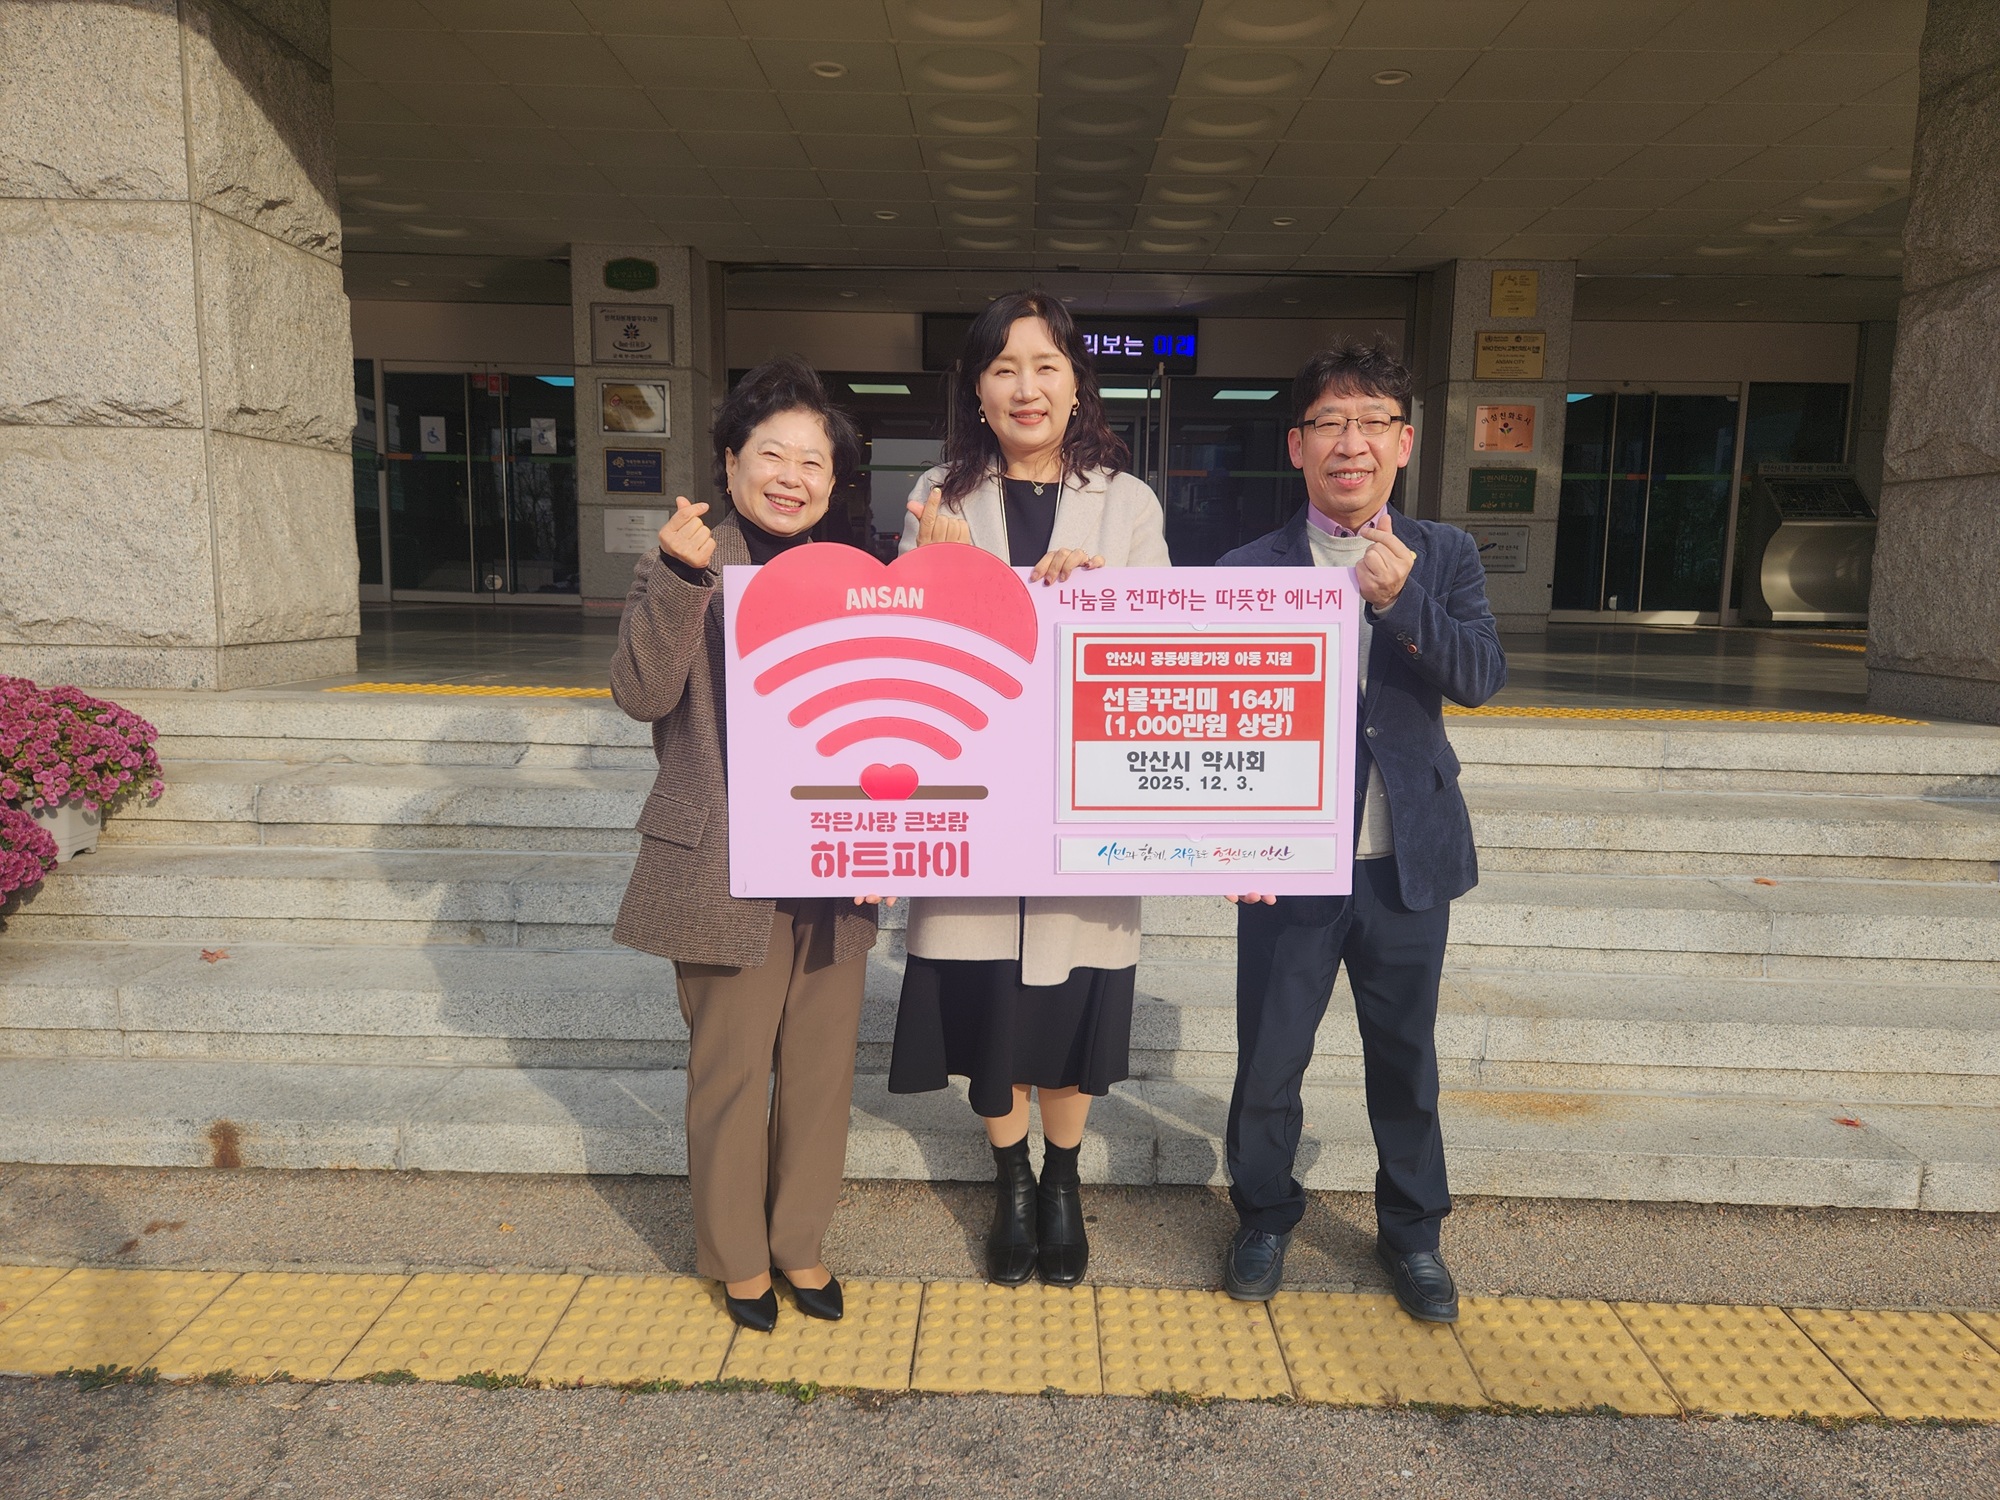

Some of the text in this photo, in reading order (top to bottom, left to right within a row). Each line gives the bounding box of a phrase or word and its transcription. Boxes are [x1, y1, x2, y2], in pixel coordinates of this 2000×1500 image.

[1154, 335, 1195, 357] 미래
[846, 585, 924, 611] ANSAN
[1059, 588, 1343, 612] 나눔을 전파하는 따뜻한 에너지
[1105, 651, 1293, 667] 안산시 공동생활가정 아동 지원
[1102, 687, 1295, 712] 선물꾸러미 164개
[1104, 713, 1293, 738] (1,000만원 상당)
[1126, 750, 1265, 773] 안산시 약사회
[1138, 776, 1253, 792] 2025. 12. 3.
[810, 811, 970, 833] 작은사랑 큰보람
[810, 840, 970, 879] 하트파이
[1097, 841, 1138, 866] 시민과
[1169, 847, 1209, 867] 자유로운
[1213, 846, 1256, 866] 혁신도시
[1260, 845, 1296, 861] 안산
